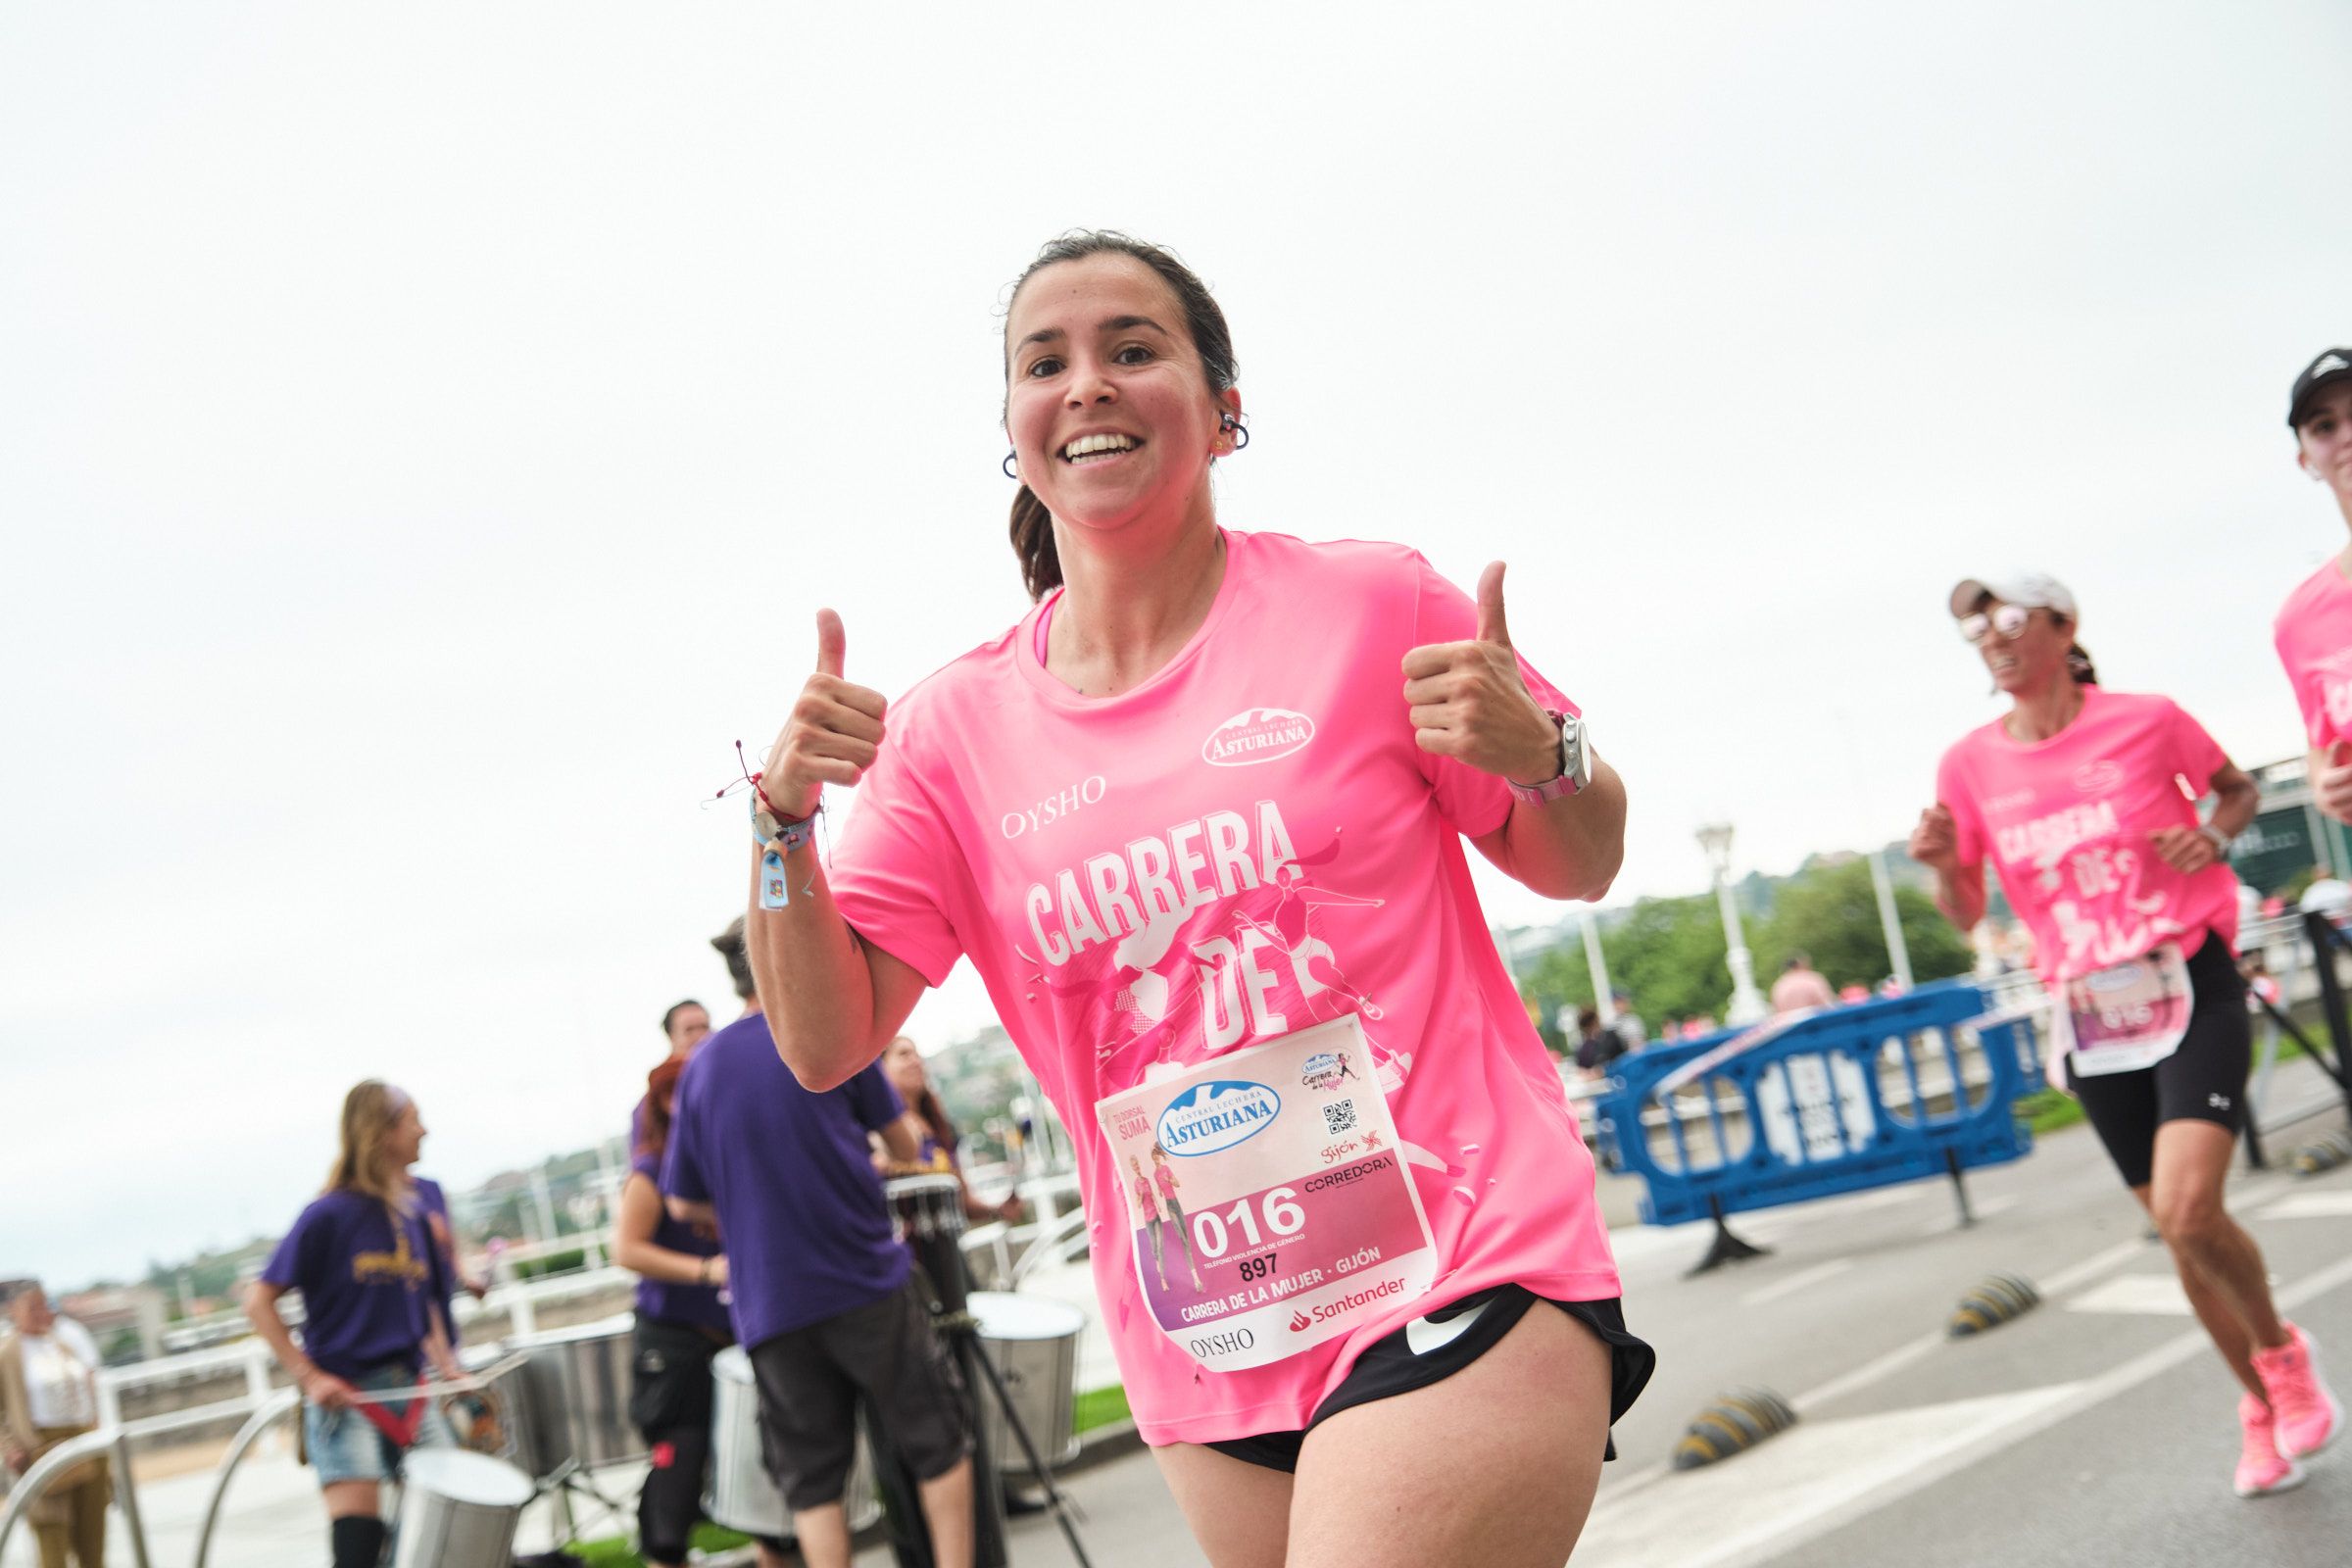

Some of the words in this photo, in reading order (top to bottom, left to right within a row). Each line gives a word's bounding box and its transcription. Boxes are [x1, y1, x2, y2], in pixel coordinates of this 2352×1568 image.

[1212, 724, 1307, 760] ASTURIANA
[1001, 775, 1106, 839] OYSHO
[1026, 799, 1304, 967] CARRERA
[1191, 921, 1289, 1051] DE
[1166, 1099, 1273, 1149] ASTURIANA
[1176, 1106, 1214, 1124] CENTRAL
[1217, 1090, 1262, 1110] LECHERA
[1118, 1115, 1152, 1141] SUMA
[1321, 1140, 1358, 1164] gijón
[1304, 1156, 1393, 1193] CORREDORA
[1193, 1187, 1306, 1258] 016
[1232, 1246, 1267, 1262] VIOLENCIA
[1267, 1241, 1277, 1250] DE
[1277, 1233, 1306, 1248] GÉNERO
[1181, 1298, 1229, 1323] CARRERA
[1229, 1292, 1249, 1310] DE
[1248, 1286, 1269, 1303] LA
[1273, 1268, 1324, 1298] MUJER
[1336, 1246, 1382, 1274] GIJÓN
[1239, 1252, 1278, 1283] 897
[1311, 1278, 1405, 1323] Santander
[1190, 1327, 1255, 1359] OYSHO
